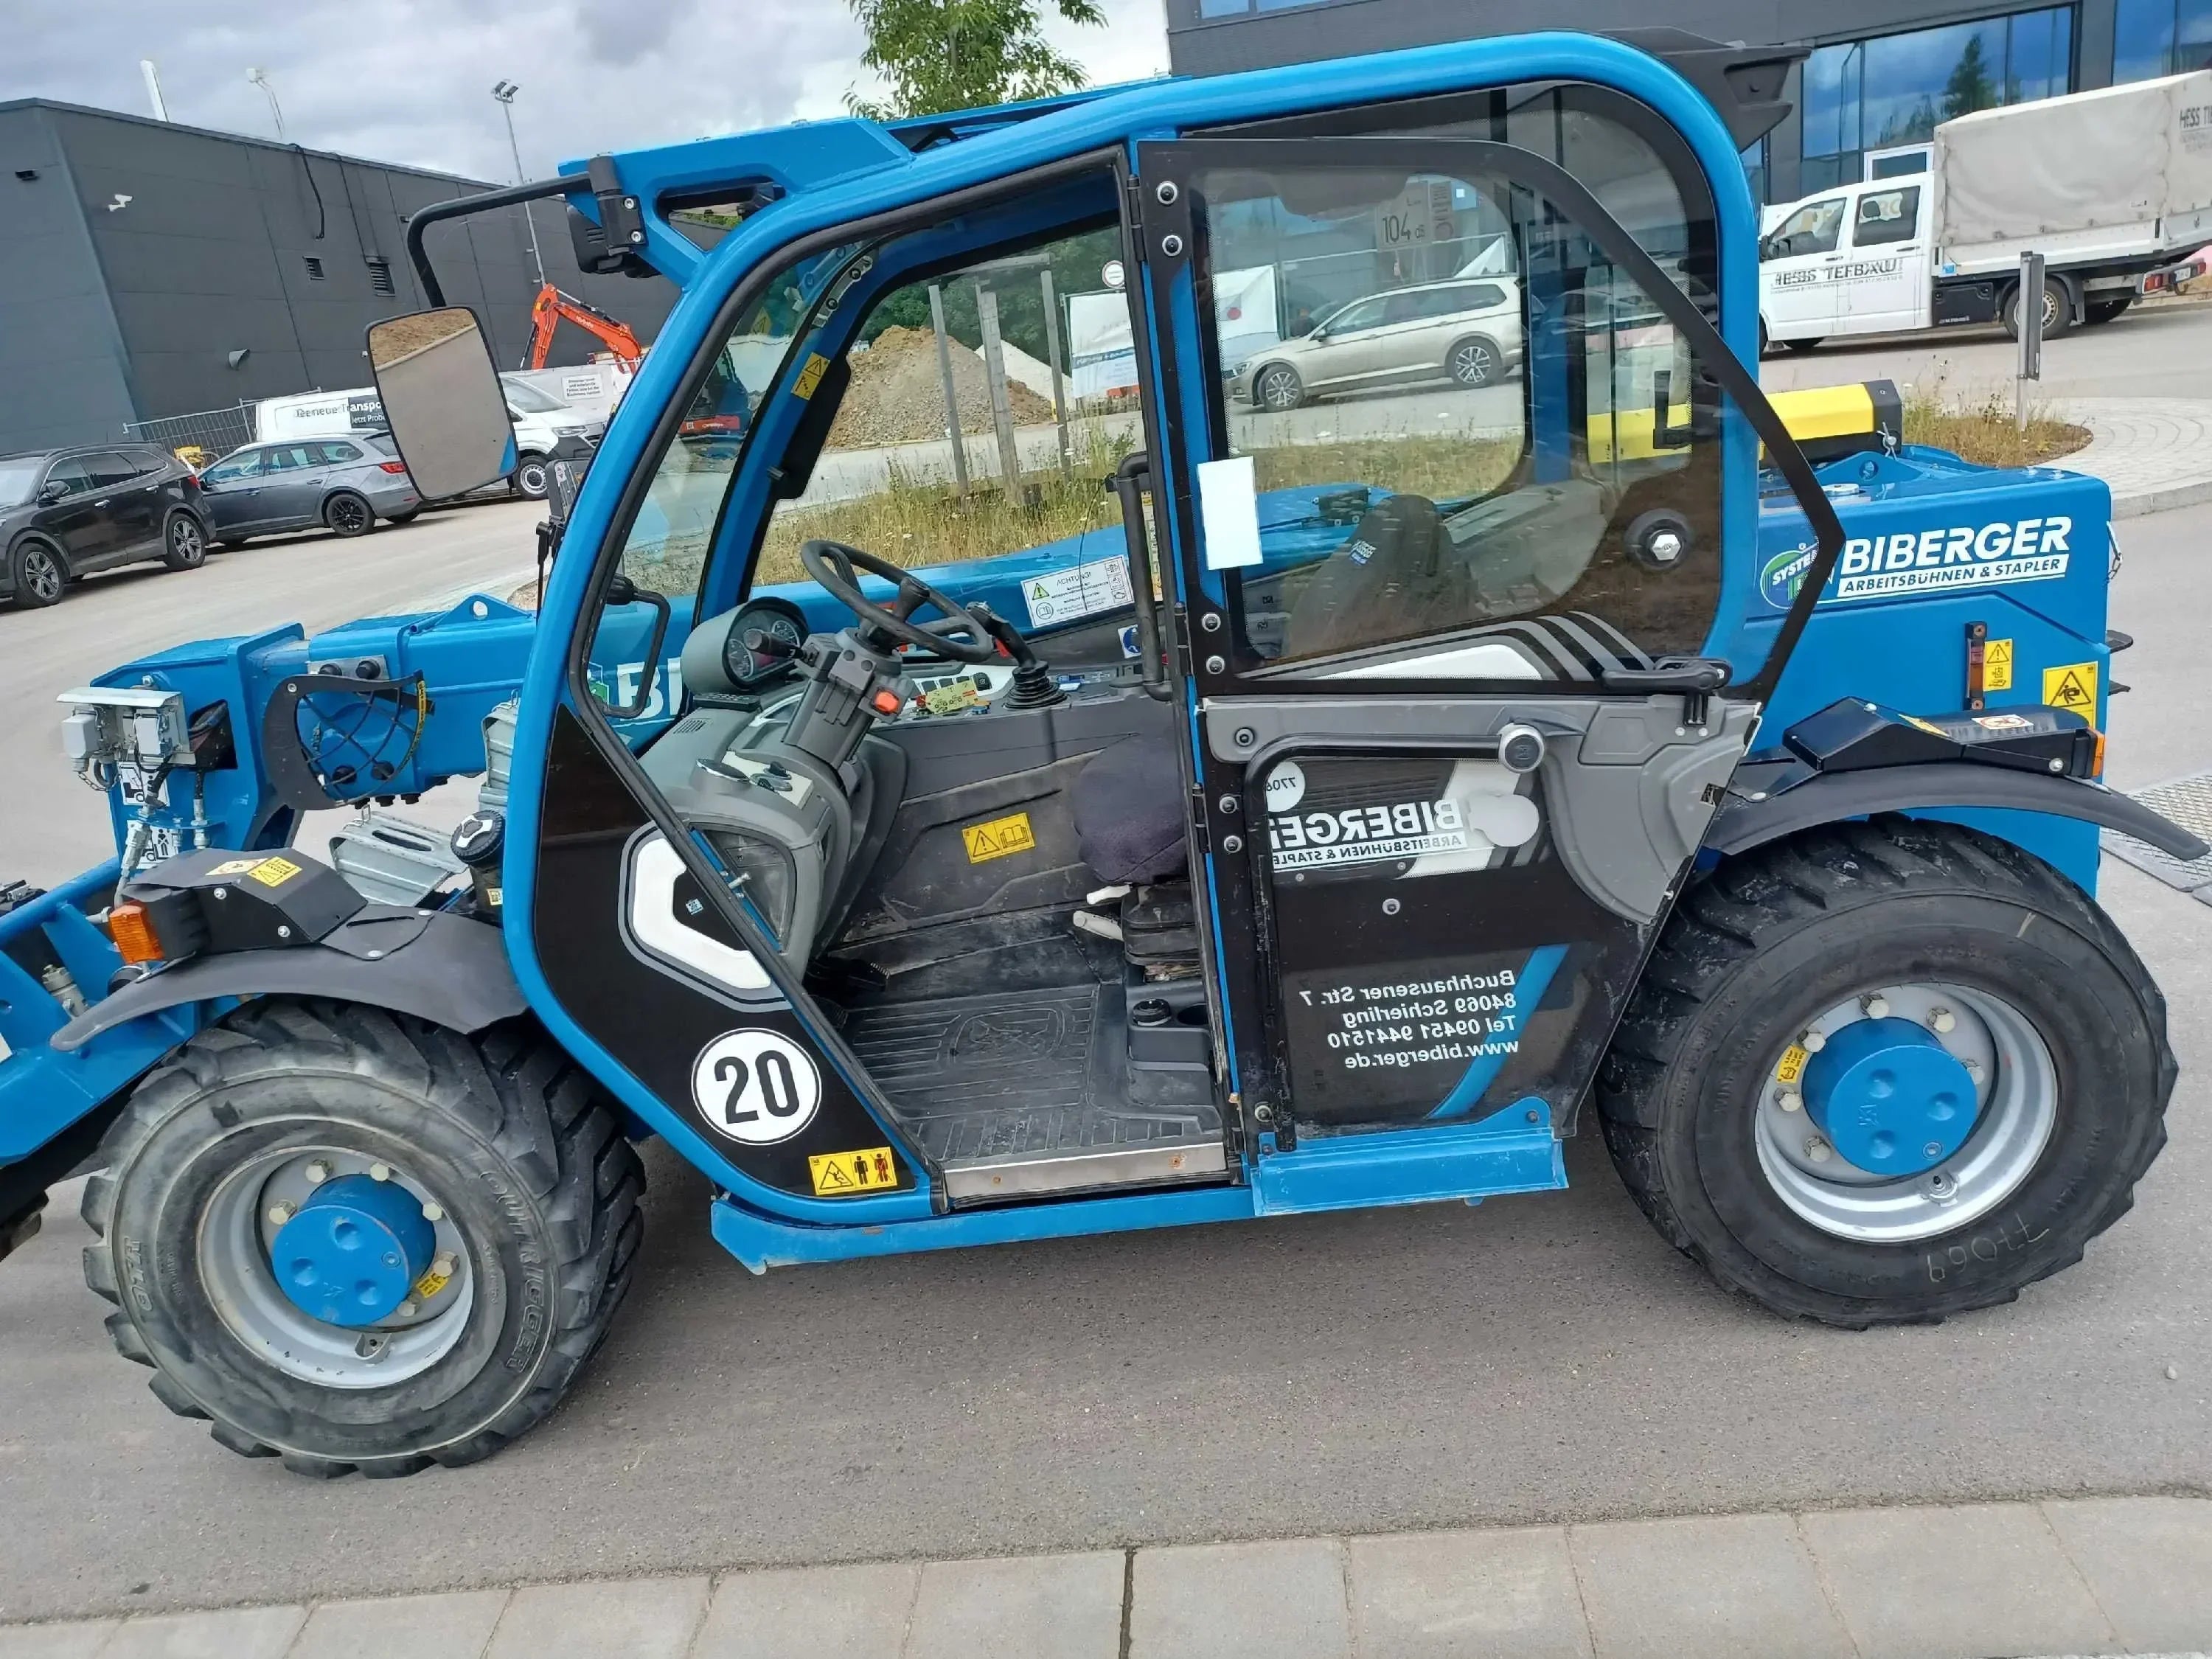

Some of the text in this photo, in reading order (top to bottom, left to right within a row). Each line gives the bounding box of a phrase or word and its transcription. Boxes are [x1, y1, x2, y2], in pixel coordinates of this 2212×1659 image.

[1382, 211, 1411, 243] 104
[1841, 515, 2073, 575] BIBERGER
[1843, 557, 2062, 593] ARBEITSBÜHNEN & STAPLER
[713, 1049, 800, 1124] 20
